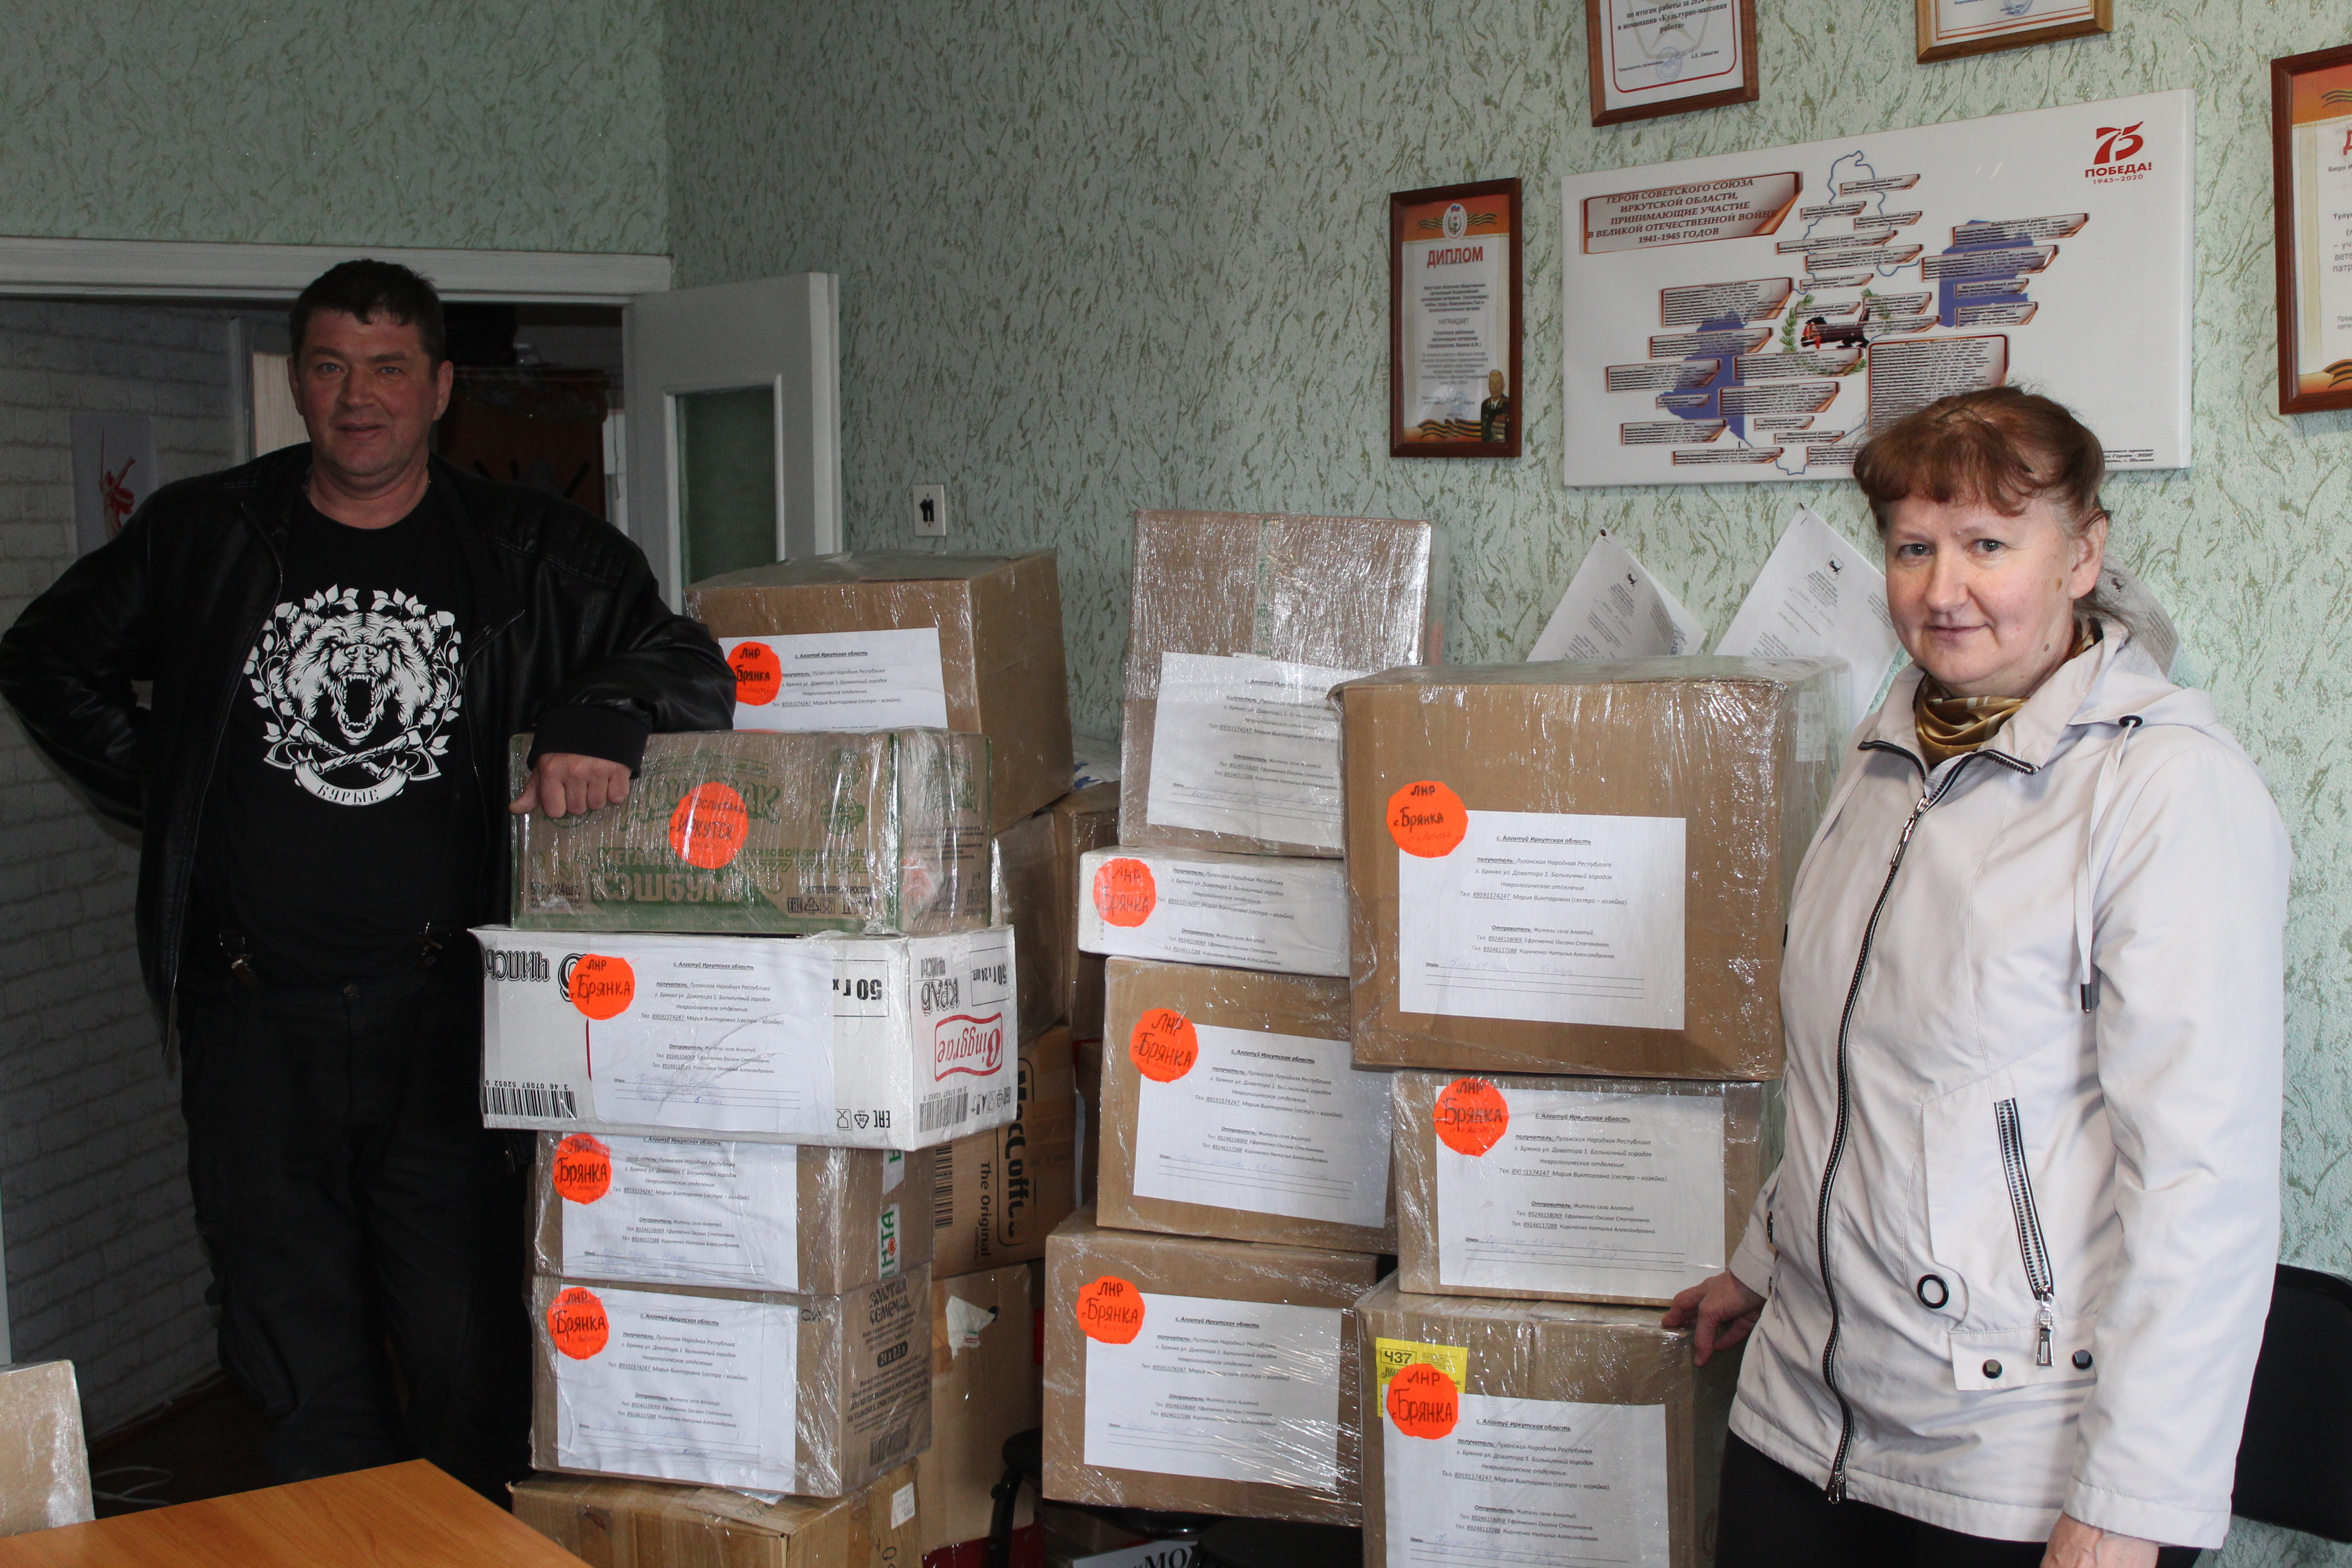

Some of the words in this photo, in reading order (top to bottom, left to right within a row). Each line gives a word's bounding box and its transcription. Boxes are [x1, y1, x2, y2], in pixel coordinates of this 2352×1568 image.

[1636, 8, 1657, 17] итогам
[1659, 2, 1681, 14] работы
[1623, 18, 1657, 30] номинации
[1660, 23, 1685, 34] работа»
[2094, 121, 2143, 165] 75
[2085, 162, 2152, 178] ПОБЕДА!
[1606, 193, 1639, 204] ГЕРОИ
[1642, 184, 1711, 200] СОВЕТСКОГО
[1714, 179, 1754, 190] СОЮЗА
[1620, 198, 1683, 213] ИРКУТСКОЙ
[1686, 192, 1738, 206] ОБЛАСТИ,
[1611, 207, 1698, 225] ПРИНИМАЮЩИЕ
[1700, 201, 1750, 214] УЧАСТИЕ
[1597, 224, 1643, 237] ВЕЛИКОЙ
[1645, 214, 1735, 231] ОТЕЧЕСТВЕННОЙ
[1738, 210, 1776, 221] ВОЙНЕ
[1638, 232, 1681, 243] 1941-1945
[1683, 228, 1720, 239] ГОДОВ
[1427, 246, 1483, 269] ДИПЛОМ
[740, 648, 760, 658] ЛНР
[318, 784, 380, 804] БУРЫЕ
[1411, 786, 1435, 796] ЛНР
[587, 959, 606, 971] ЛНР
[857, 979, 882, 1000] 50
[1151, 1013, 1184, 1032] ЛНР
[937, 1027, 1000, 1068] Binggrae
[1261, 1053, 1290, 1061] Иркутская
[1456, 1080, 1484, 1093] ЛНР
[980, 1161, 991, 1191] The
[979, 1196, 991, 1256] Original
[566, 1291, 587, 1303] ЛНР
[1098, 1282, 1123, 1296] ЛНР
[1407, 1372, 1440, 1384] ЛНР
